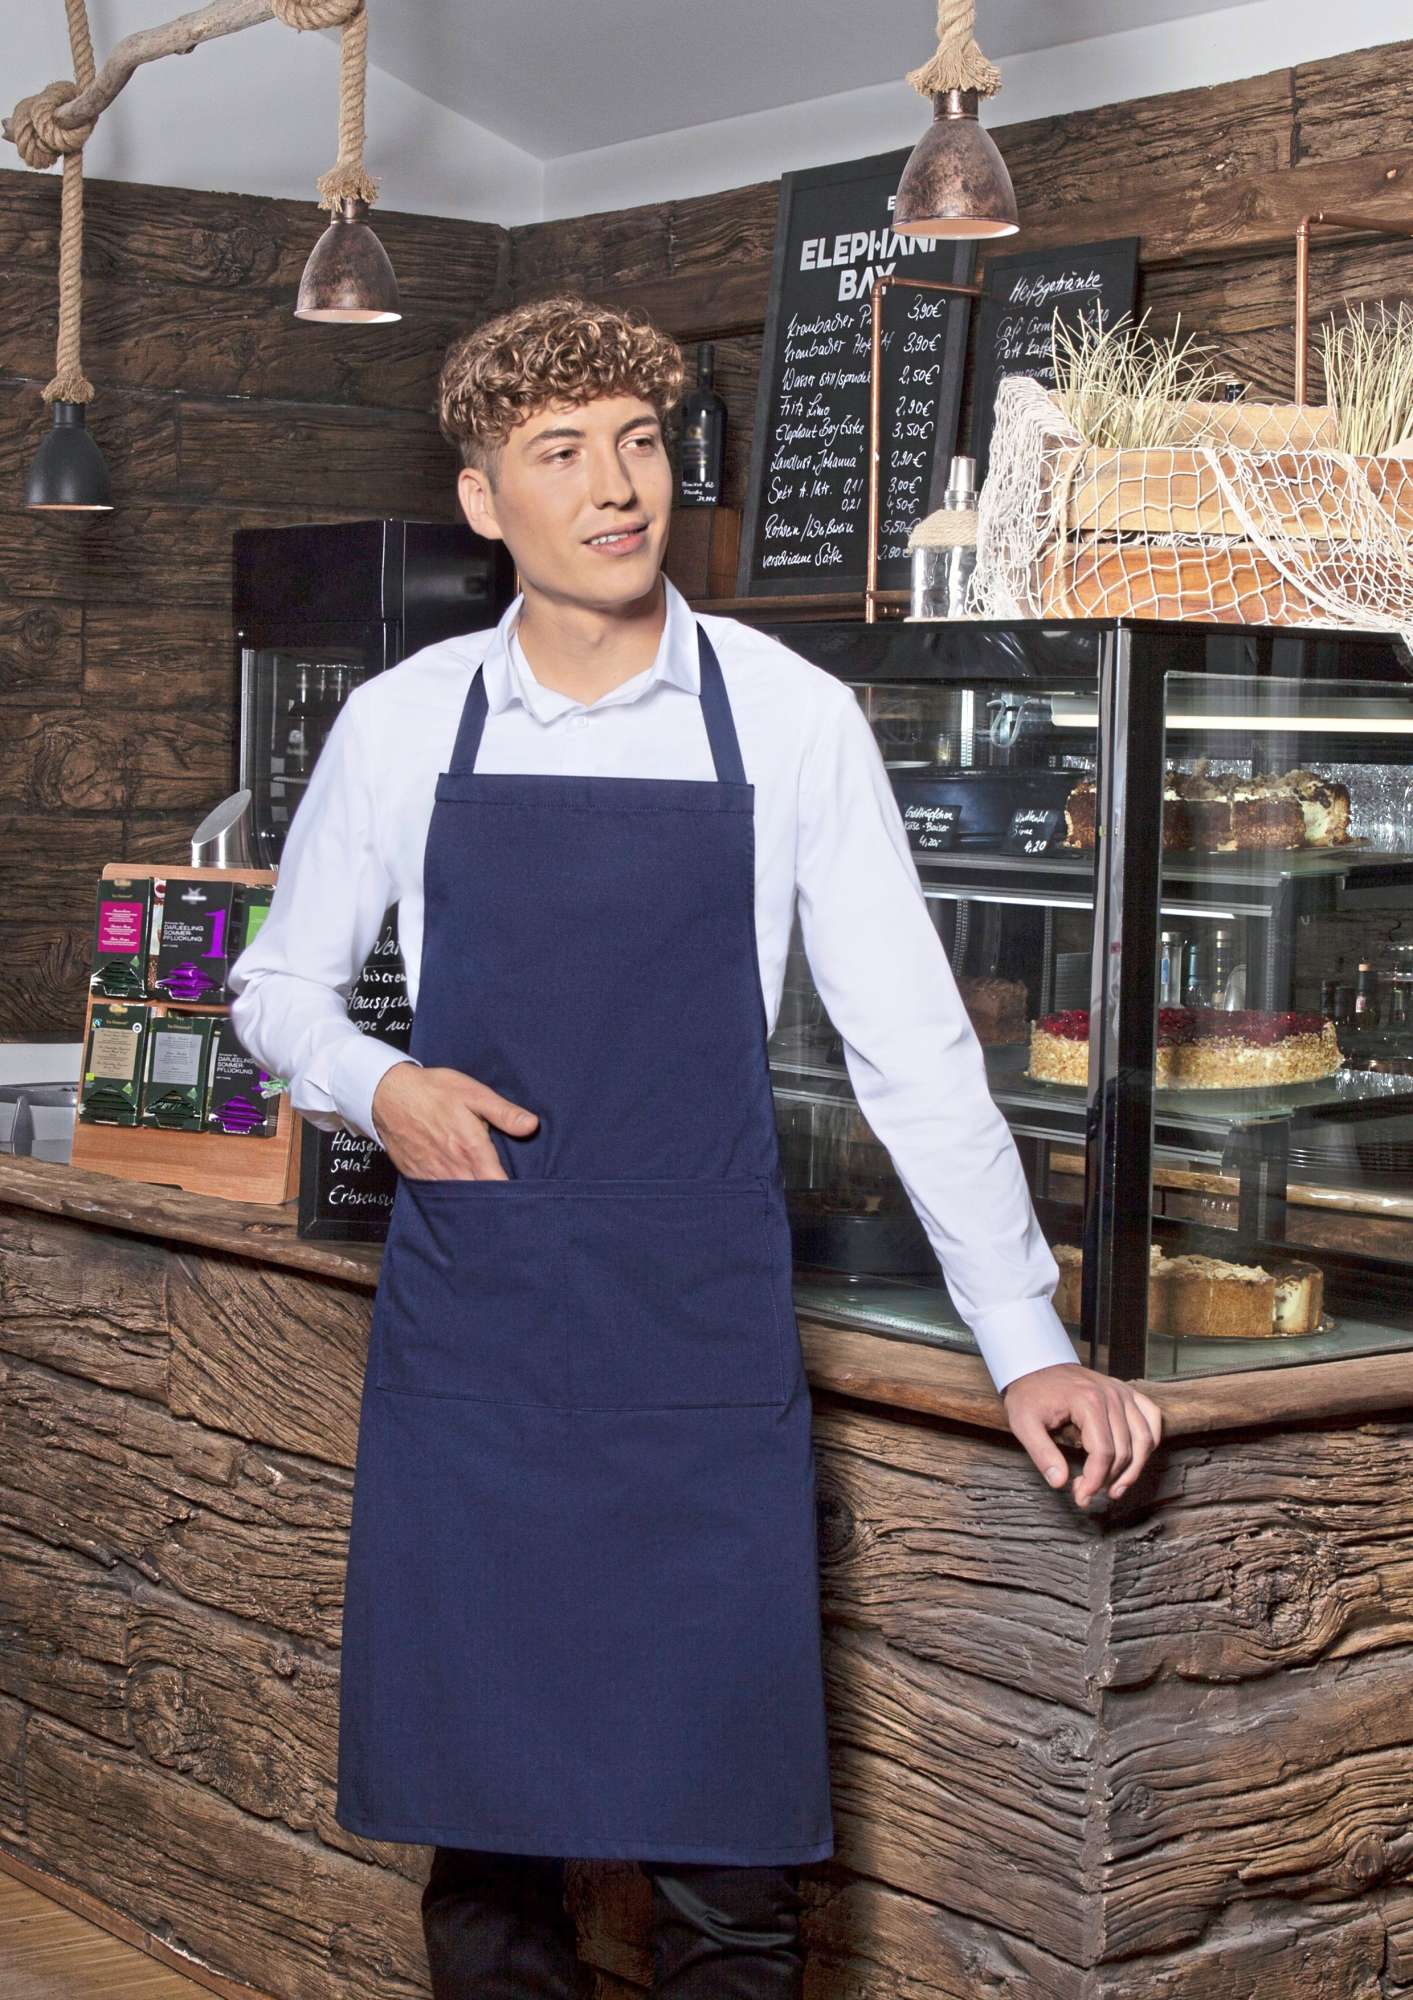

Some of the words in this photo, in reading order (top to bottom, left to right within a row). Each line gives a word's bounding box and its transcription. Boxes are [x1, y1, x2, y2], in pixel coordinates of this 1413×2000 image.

[838, 262, 896, 301] BAY
[907, 294, 946, 321] 3,90€
[903, 332, 941, 354] 3,90€
[899, 364, 940, 385] 2,50€
[806, 393, 830, 418] Limo
[892, 421, 934, 440] 3,50€
[1024, 840, 1047, 853] 4,20
[202, 909, 226, 957] 1
[328, 1184, 394, 1216] Erbsensu
